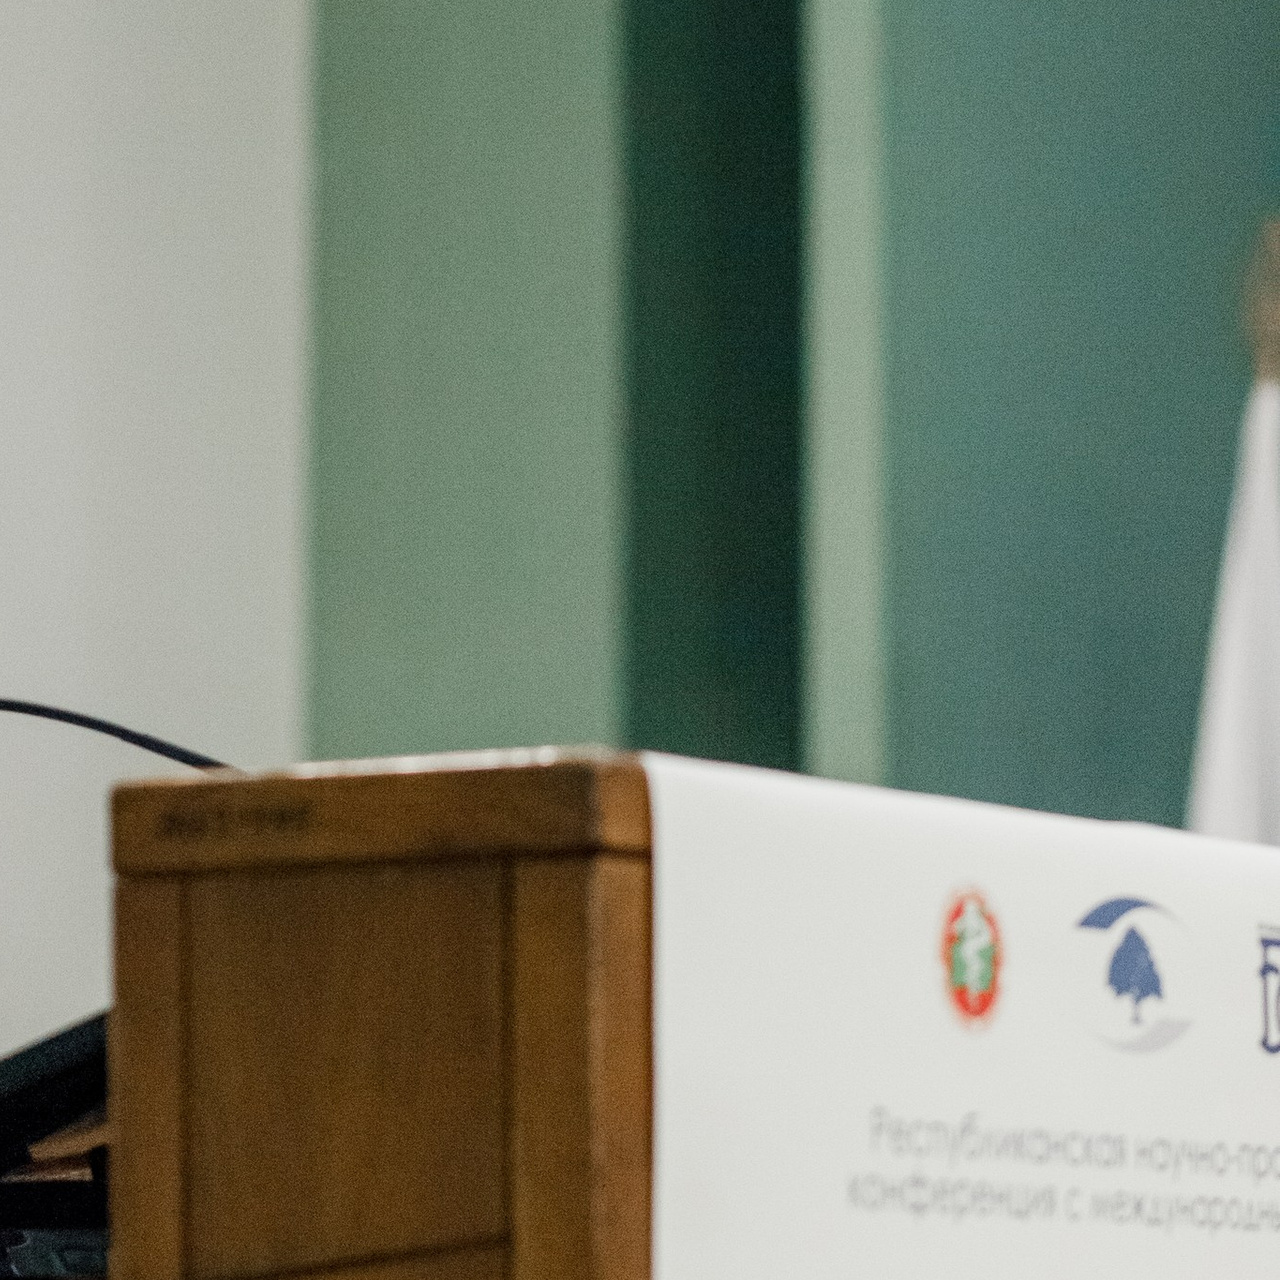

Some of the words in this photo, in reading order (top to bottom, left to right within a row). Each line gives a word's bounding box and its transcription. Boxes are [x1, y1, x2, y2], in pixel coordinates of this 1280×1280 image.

[869, 1105, 1128, 1170] Республиканская
[846, 1170, 1059, 1225] конференция
[1064, 1186, 1083, 1224] с
[1091, 1180, 1280, 1238] международн
